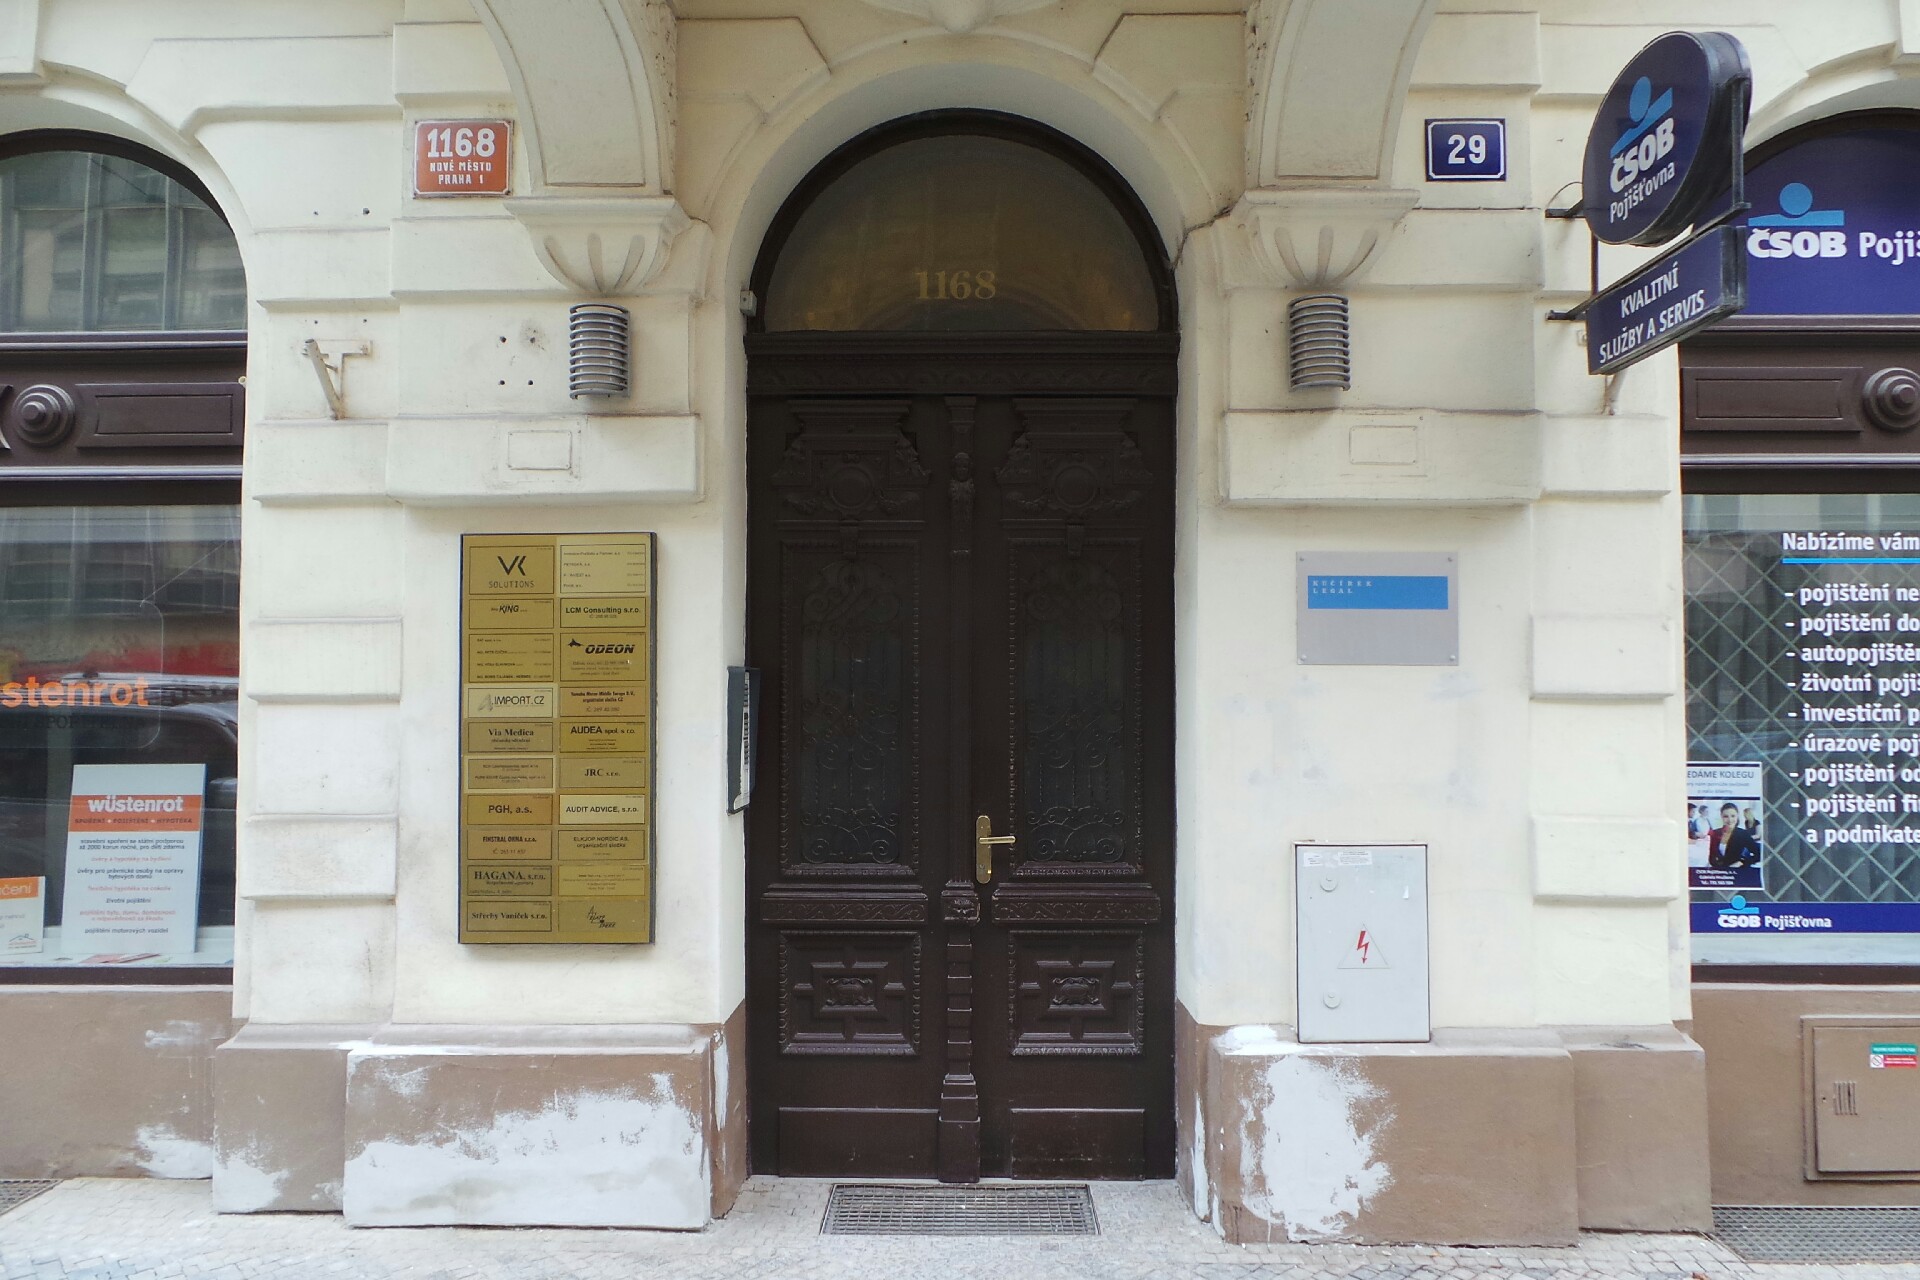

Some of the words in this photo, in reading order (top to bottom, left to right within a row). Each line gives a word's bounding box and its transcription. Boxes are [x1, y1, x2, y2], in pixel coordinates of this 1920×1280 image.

[427, 127, 496, 158] 1168
[1447, 134, 1486, 164] 29
[1609, 117, 1675, 193] ČSOB
[429, 160, 455, 172] NOVÉ
[458, 160, 492, 172] MĚSTO
[438, 174, 472, 185] PRAHA
[1610, 161, 1676, 224] Pojišťovna
[1746, 227, 1848, 259] ČSOB
[914, 269, 997, 300] 1168
[1620, 260, 1679, 319] KVALITNÍ
[1599, 322, 1644, 364] SLUŽBY
[1646, 317, 1656, 340] A
[1659, 289, 1705, 333] SERVIS
[1782, 531, 1875, 551] Nabízíme
[1880, 531, 1920, 551] vám
[488, 580, 536, 589] SOLUTIONS
[1800, 583, 1890, 607] pojištění
[1895, 587, 1920, 602] ne
[565, 606, 582, 614] LCM
[583, 606, 622, 615] Consulting
[1801, 613, 1891, 637] pojištění
[585, 644, 636, 655] ODEON
[1, 676, 149, 708] stenrot
[1801, 673, 1872, 692] životní
[1802, 702, 1902, 722] investiční
[488, 728, 502, 736] Via
[504, 728, 534, 736] Medica
[570, 726, 603, 734] AUDEA
[1804, 732, 1882, 753] úrazové
[1887, 733, 1920, 757] poj
[584, 768, 604, 777] JRC
[1719, 770, 1755, 779] KOLEGU
[1804, 763, 1896, 787] pojištění
[87, 794, 185, 812] wüstenrot
[488, 804, 513, 815] PGH,
[515, 805, 533, 814] a.s.
[589, 806, 620, 814] ADVICE,
[1805, 793, 1897, 818] pojištění
[1901, 793, 1920, 813] fi
[1805, 828, 1818, 843] a
[1824, 824, 1920, 848] podnikate
[471, 912, 499, 921] Střechy
[1717, 914, 1761, 928] ČSOB
[1764, 914, 1833, 931] Pojišťovna
